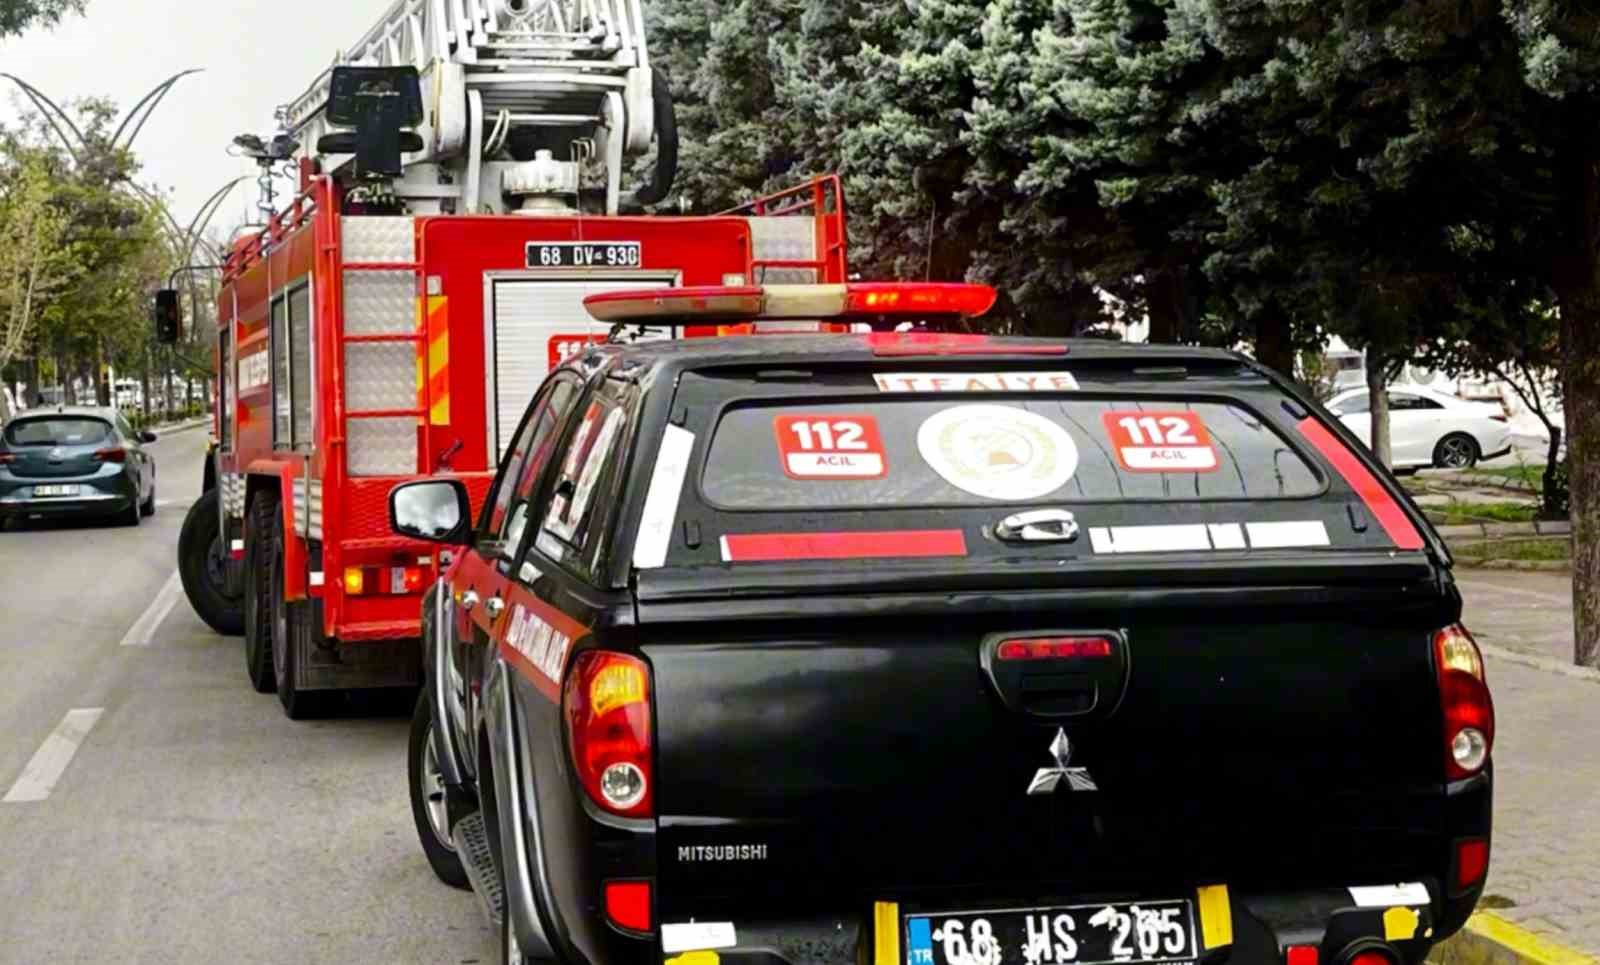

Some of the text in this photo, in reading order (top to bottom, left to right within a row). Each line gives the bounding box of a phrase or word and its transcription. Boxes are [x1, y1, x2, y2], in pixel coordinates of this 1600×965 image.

[540, 247, 561, 265] 68
[607, 247, 638, 265] 930
[791, 421, 868, 450] 112
[1119, 416, 1199, 445] 112
[678, 844, 767, 861] MITSUBISHI
[943, 918, 995, 965] 68
[1025, 914, 1079, 962] HS
